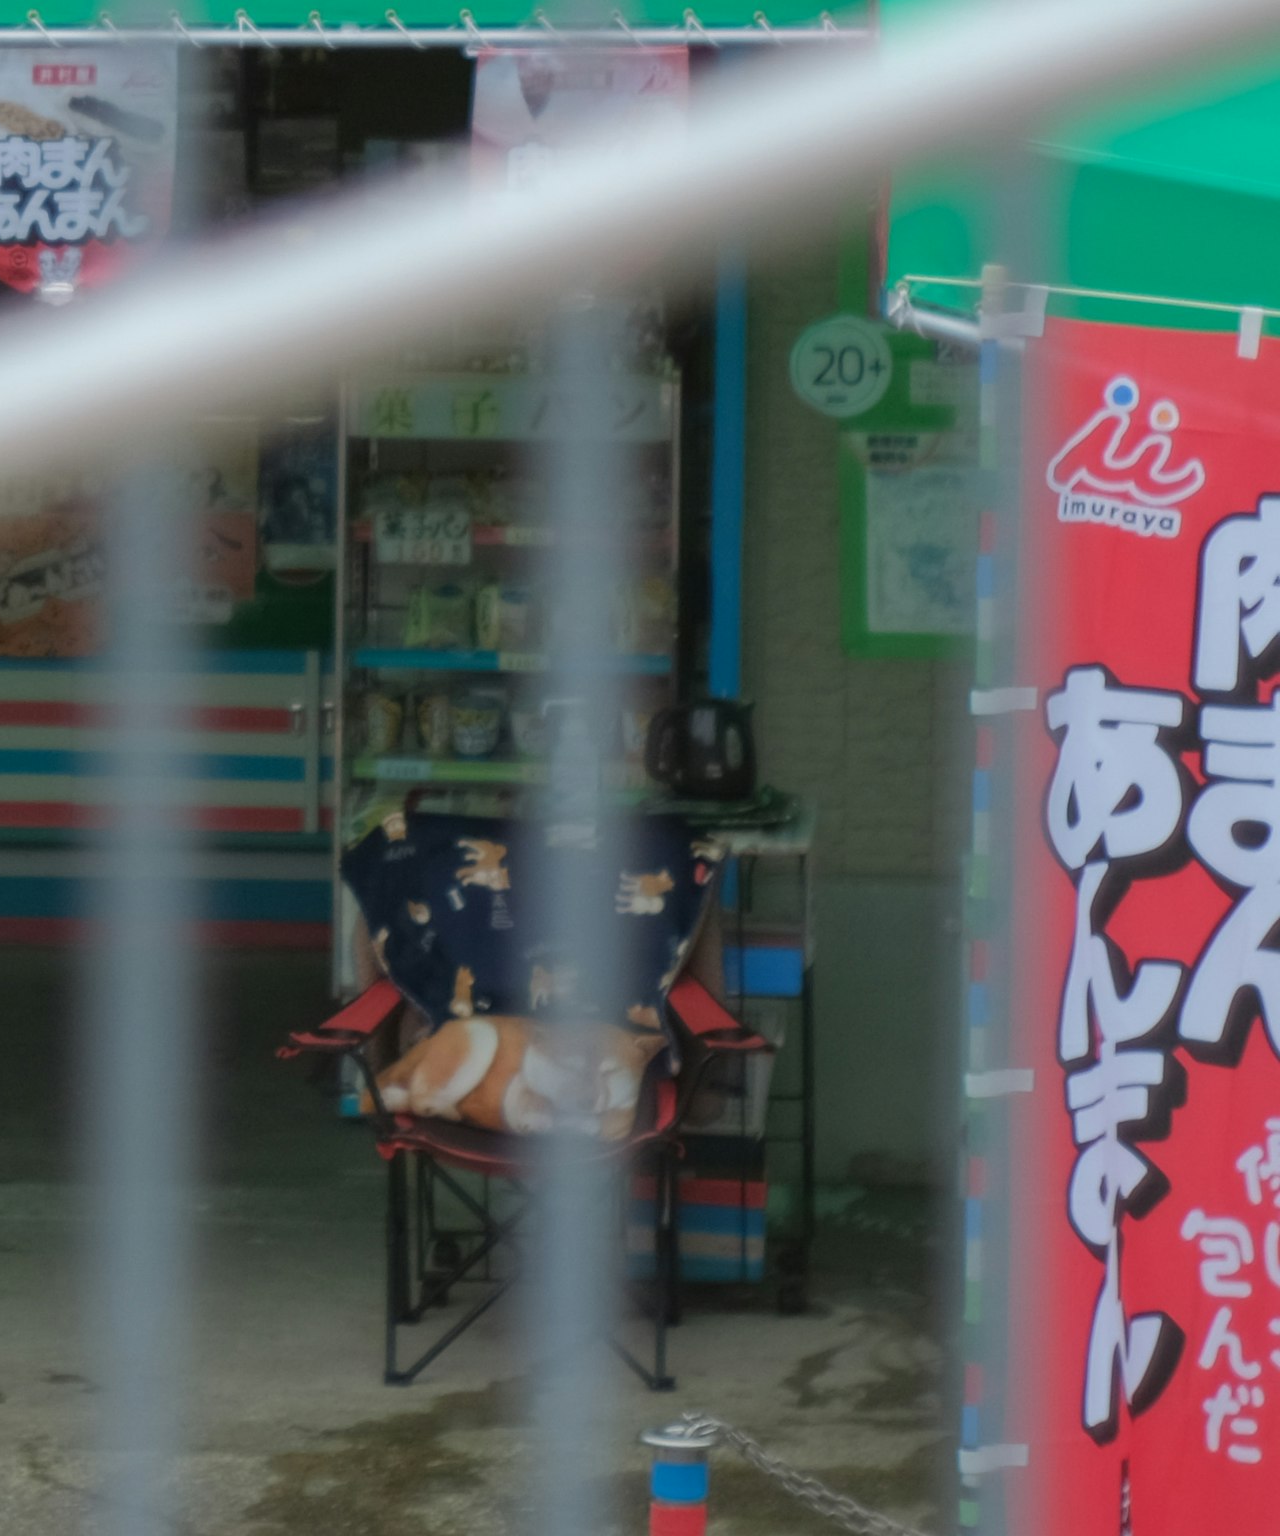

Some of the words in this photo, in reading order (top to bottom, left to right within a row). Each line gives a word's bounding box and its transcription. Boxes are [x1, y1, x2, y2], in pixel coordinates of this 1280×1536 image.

[812, 345, 886, 386] 20+
[1061, 496, 1176, 532] imuraya
[1180, 1208, 1265, 1464] 包んだ
